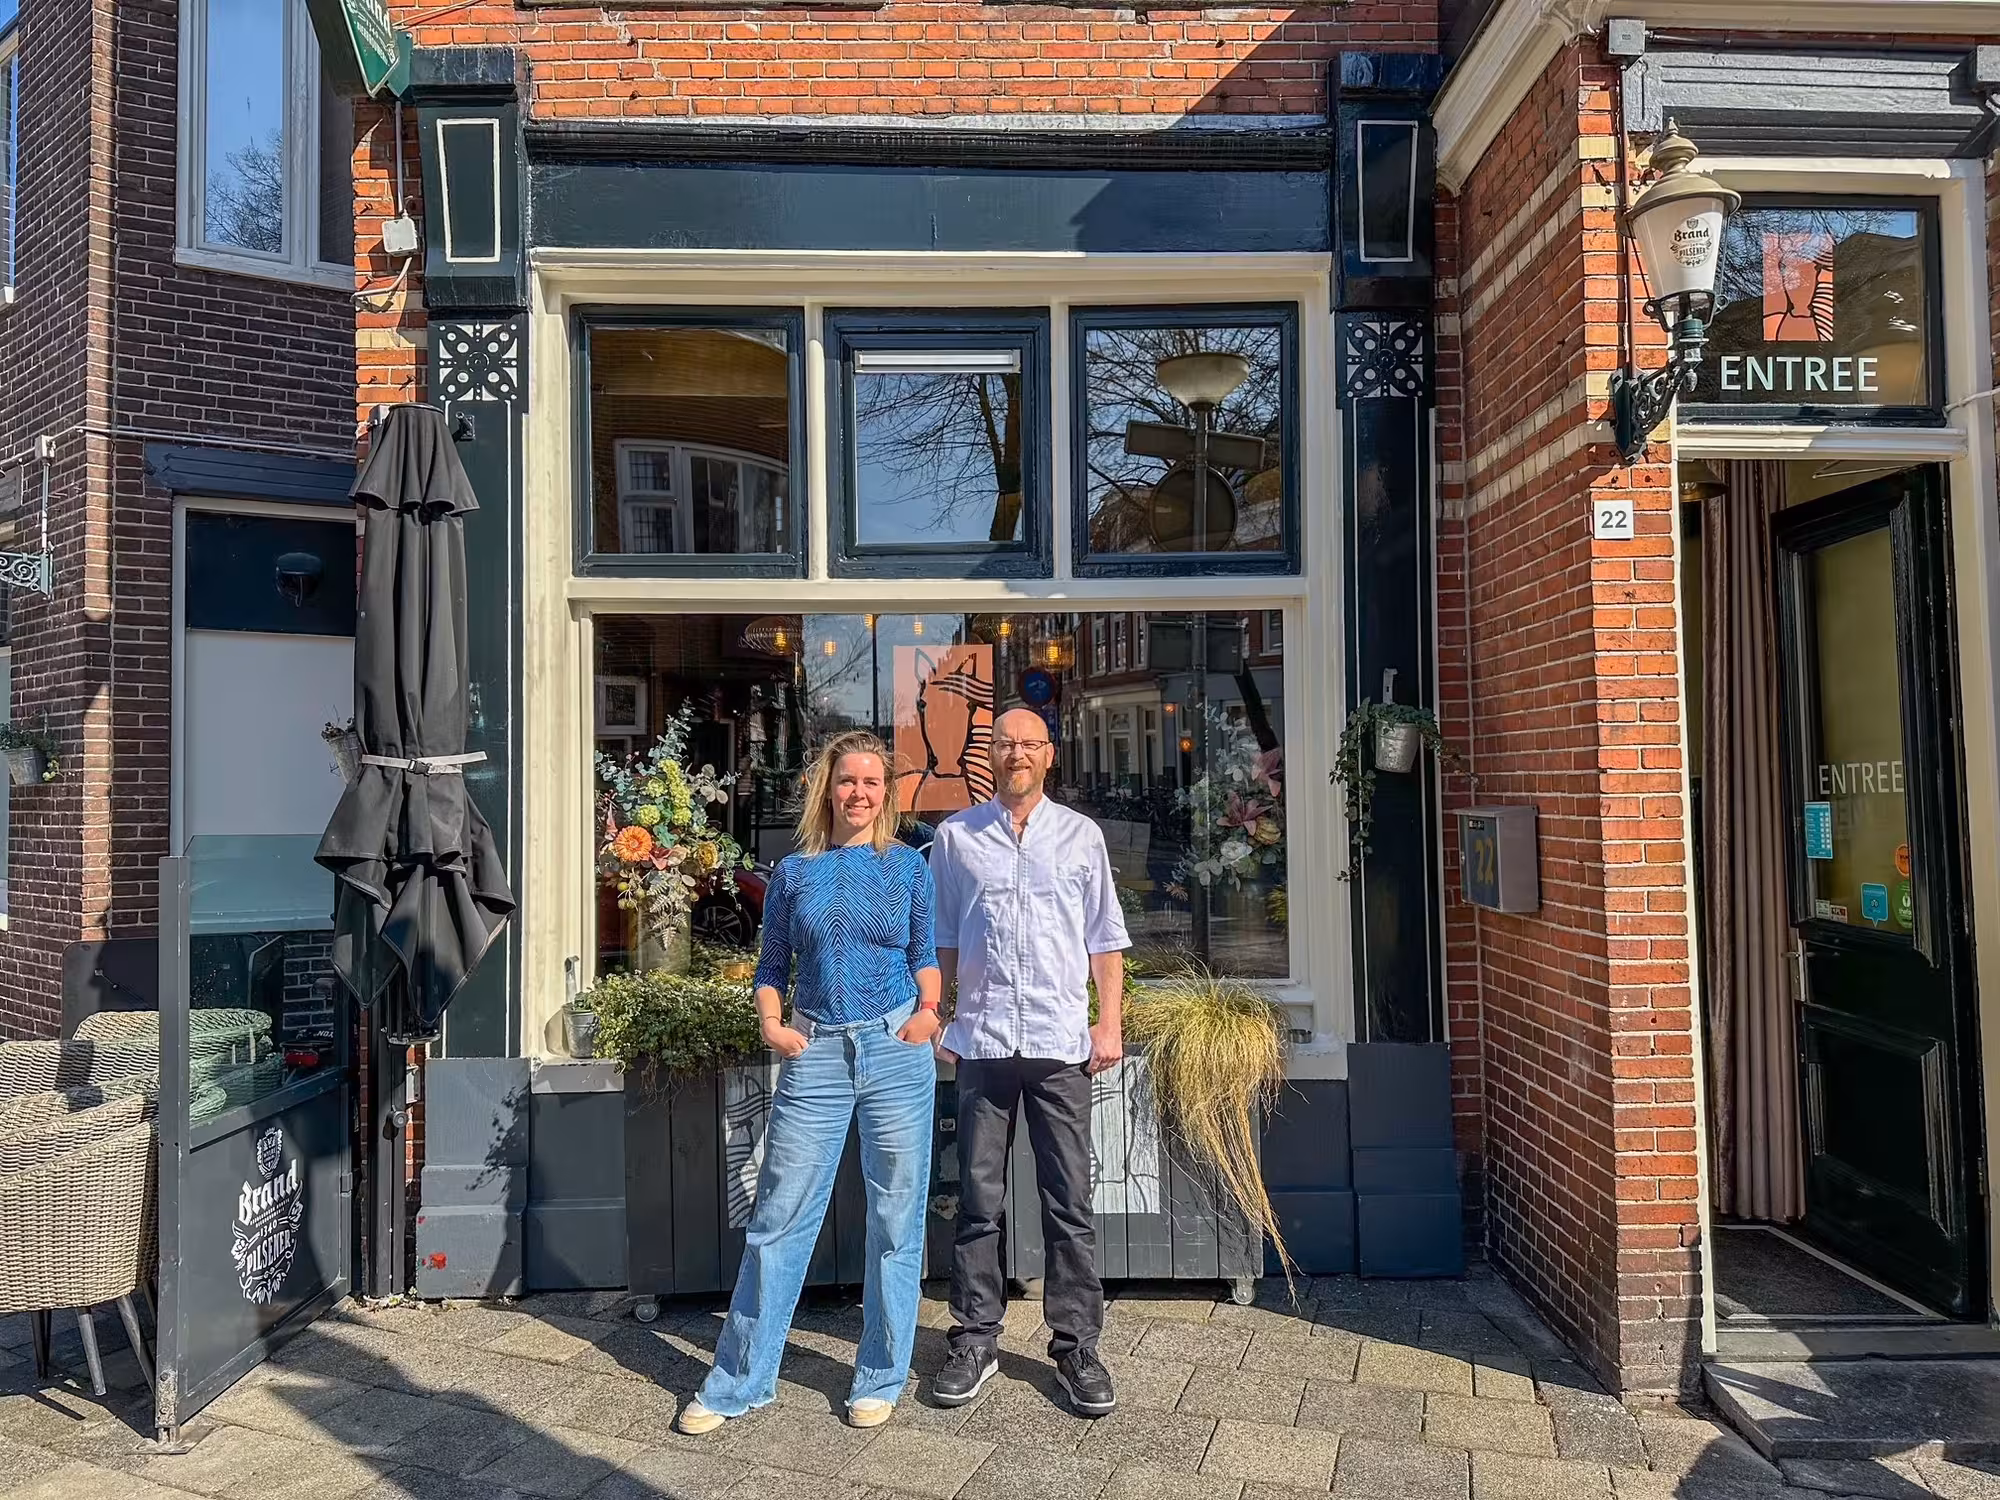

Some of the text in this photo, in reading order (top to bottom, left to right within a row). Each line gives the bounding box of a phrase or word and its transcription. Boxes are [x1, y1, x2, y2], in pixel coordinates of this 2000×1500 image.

[1674, 228, 1710, 242] Brand
[1679, 246, 1706, 257] PILSENER
[1720, 356, 1879, 392] ENTREE
[1601, 510, 1627, 529] 22
[1819, 760, 1904, 795] ENTREE
[238, 1158, 298, 1226] Brand
[260, 1219, 278, 1238] 1340
[246, 1229, 292, 1277] PILSENER
